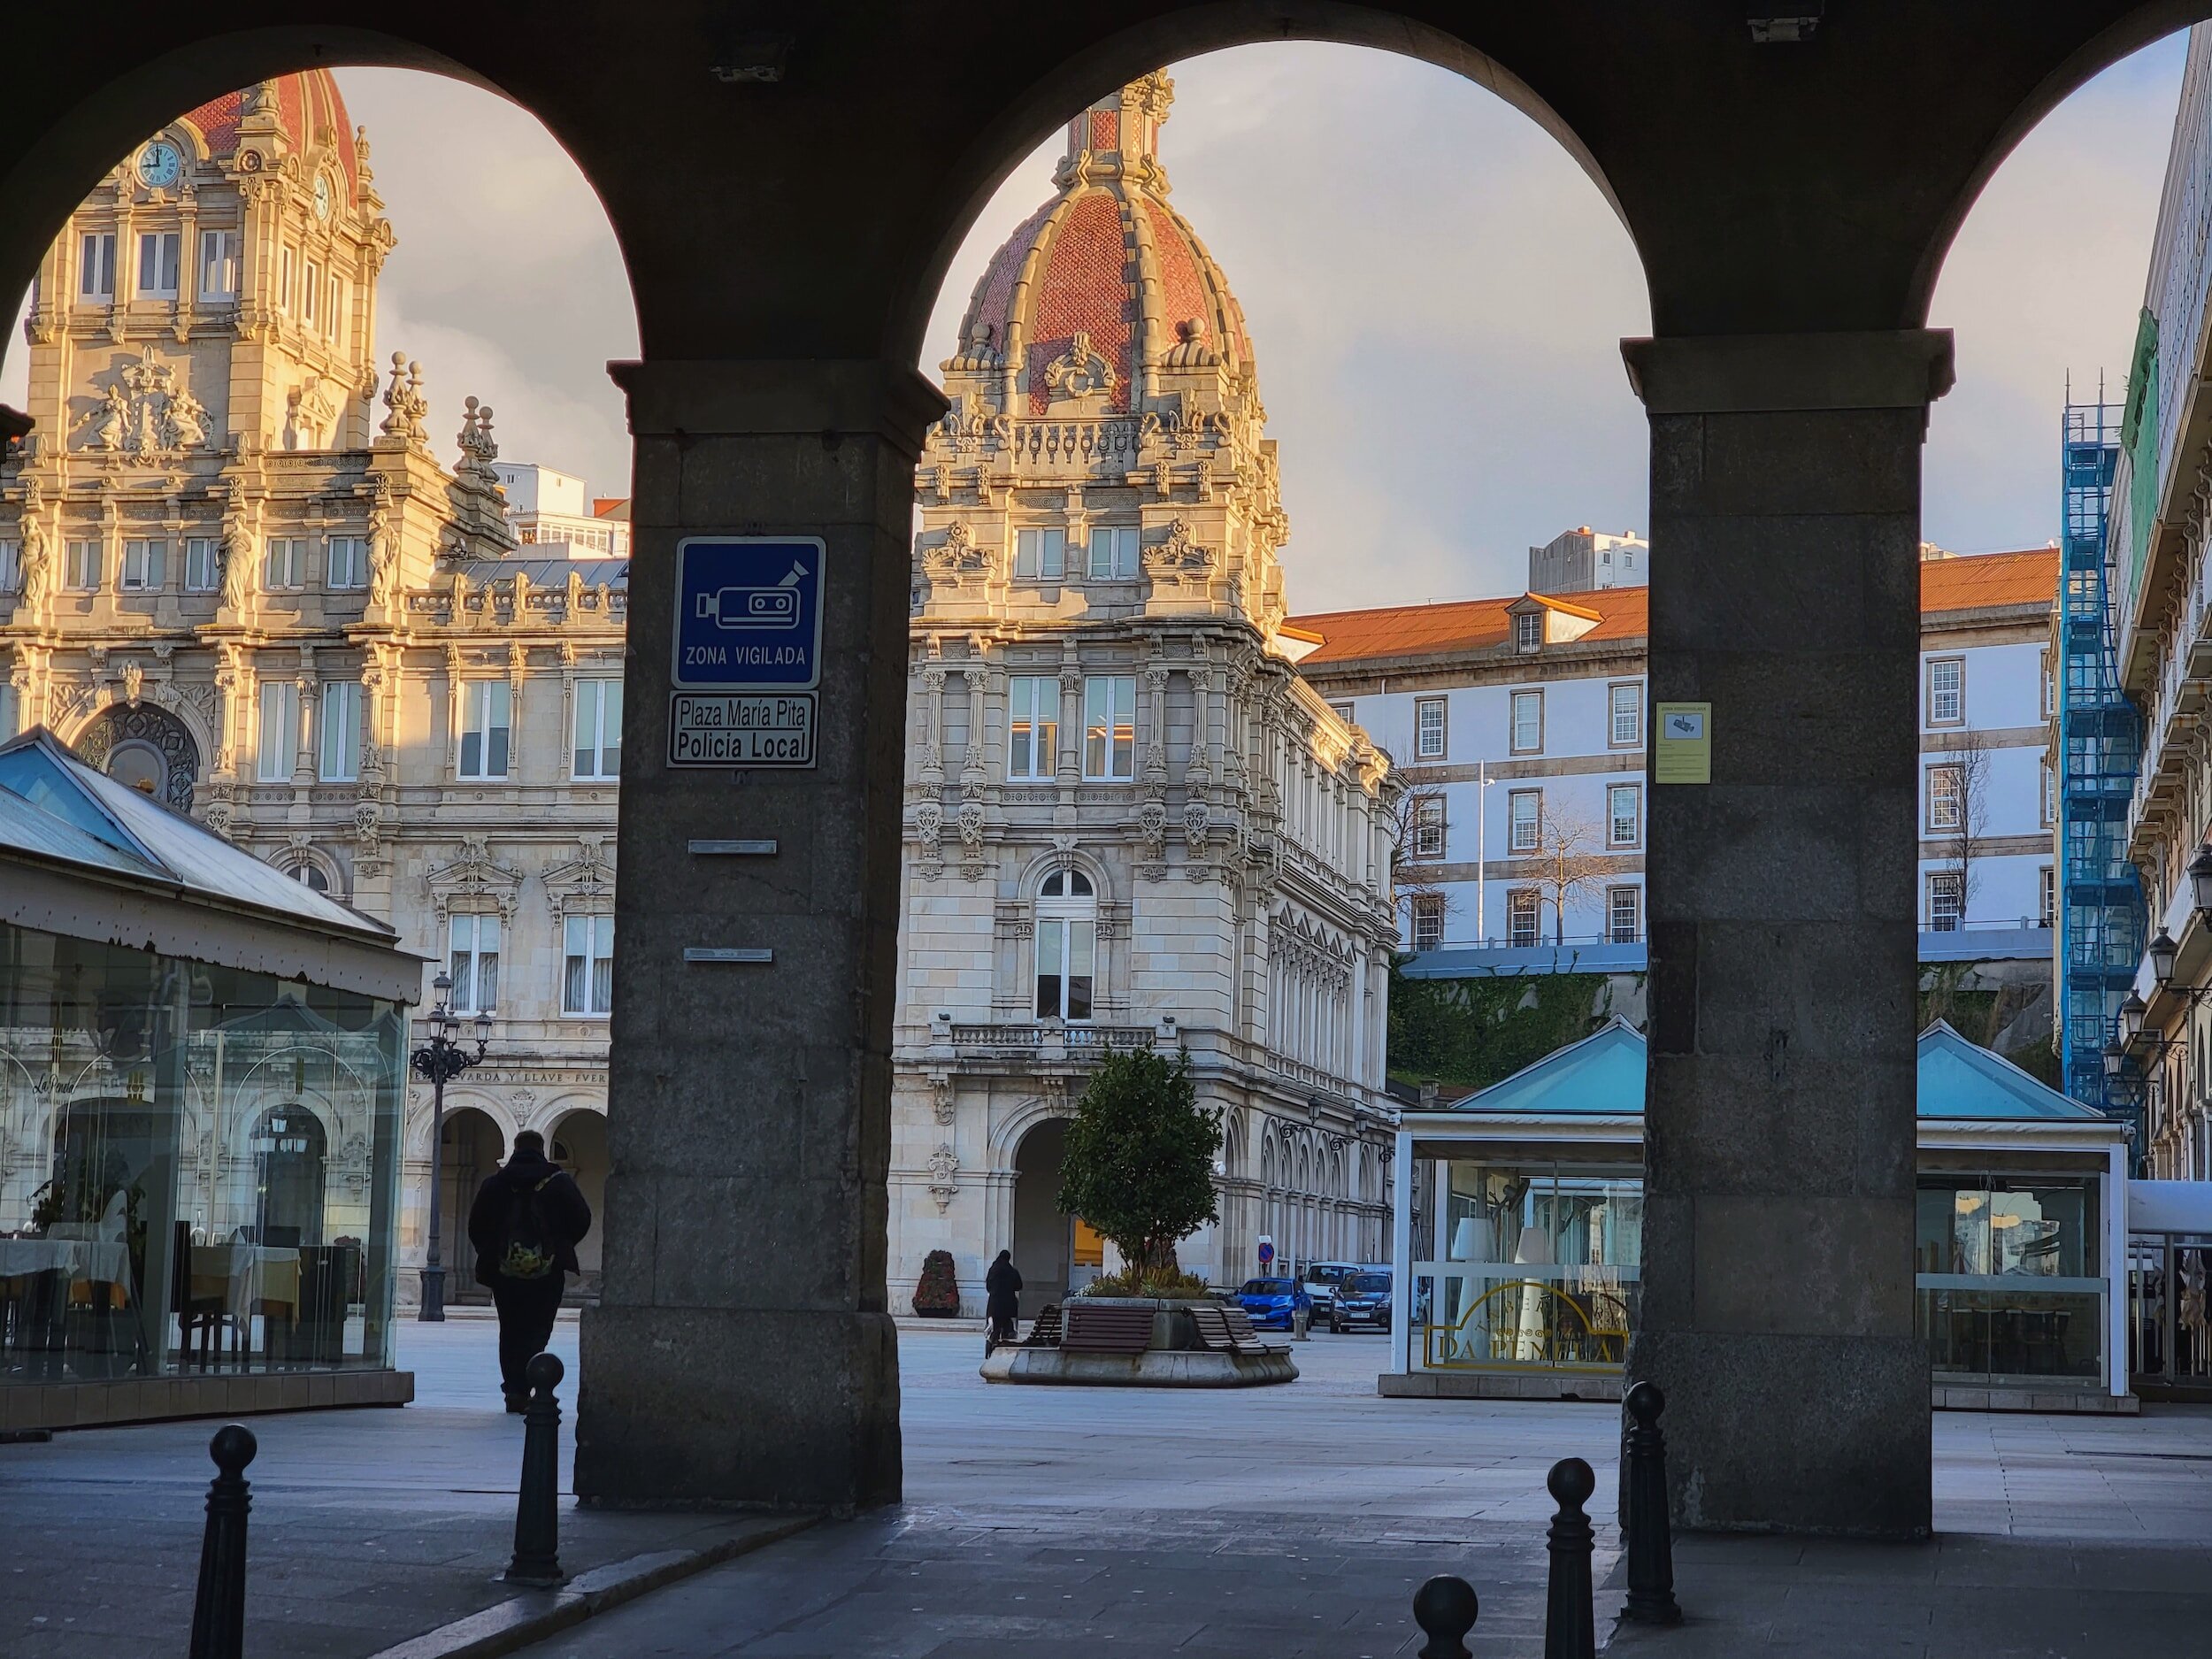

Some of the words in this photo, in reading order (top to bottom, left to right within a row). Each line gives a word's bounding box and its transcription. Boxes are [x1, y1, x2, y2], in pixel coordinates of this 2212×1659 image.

[686, 646, 727, 664] ZONA
[735, 646, 806, 665] VIGILADA
[680, 699, 722, 726] Plaza
[727, 699, 771, 726] María
[776, 699, 806, 726] Pita
[751, 732, 806, 758] Local
[459, 1071, 501, 1081] VARDA
[509, 1072, 516, 1081] Y
[524, 1072, 564, 1082] LLAVE
[575, 1073, 606, 1083] FVER
[1437, 1335, 1478, 1360] DA
